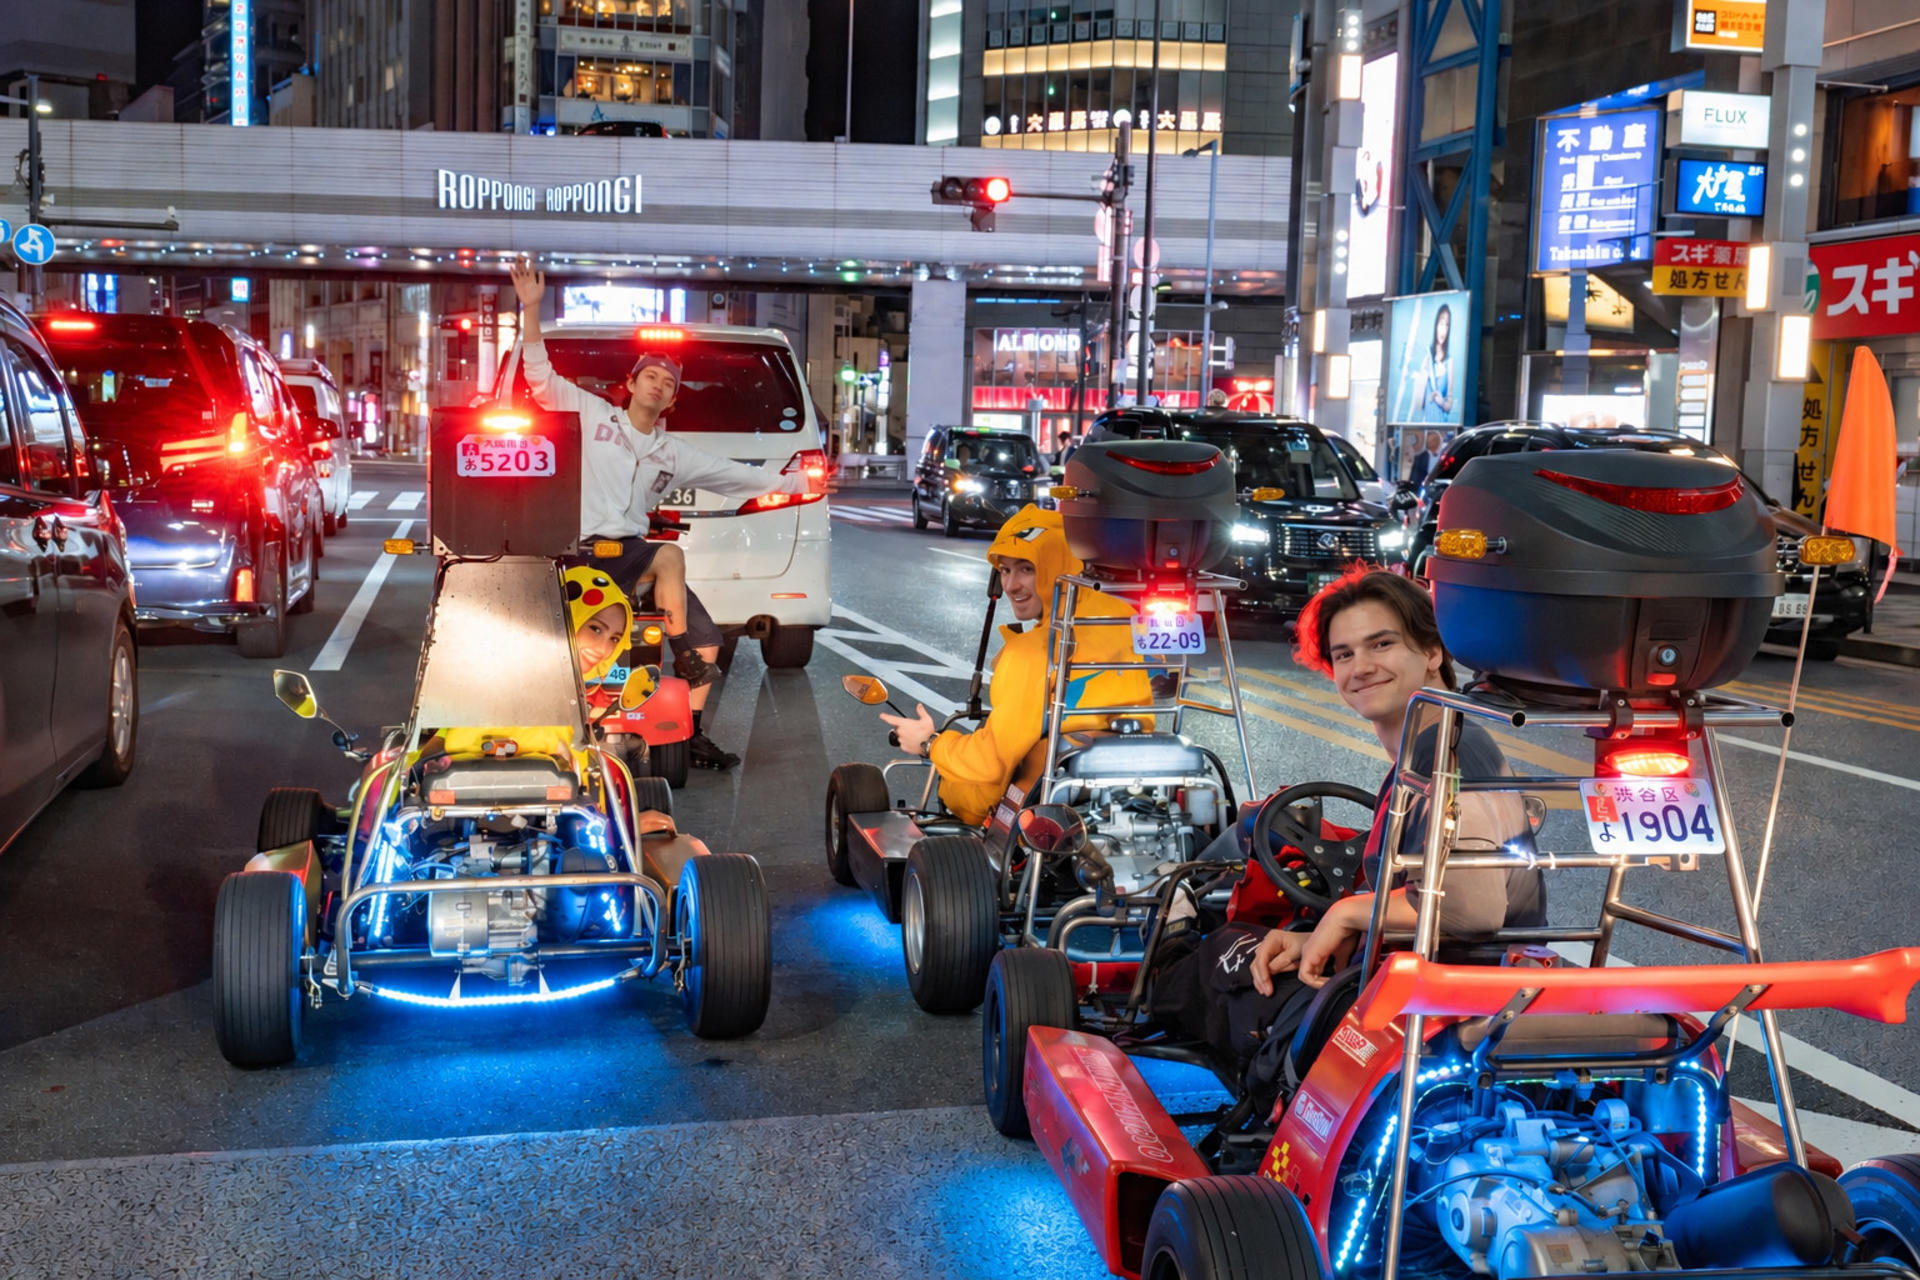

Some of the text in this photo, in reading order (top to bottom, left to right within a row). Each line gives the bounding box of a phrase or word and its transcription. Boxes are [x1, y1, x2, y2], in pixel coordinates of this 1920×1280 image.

[1704, 107, 1748, 124] FLUX
[1556, 123, 1648, 153] 不動産
[438, 168, 642, 214] ROPPONGI ROPPONGI
[998, 333, 1081, 351] ALMOND
[480, 450, 549, 472] 5203
[1798, 397, 1823, 518] 処方せん
[1149, 632, 1201, 649] 22-09
[1614, 786, 1680, 802] 渋谷区
[1621, 803, 1715, 843] 1904
